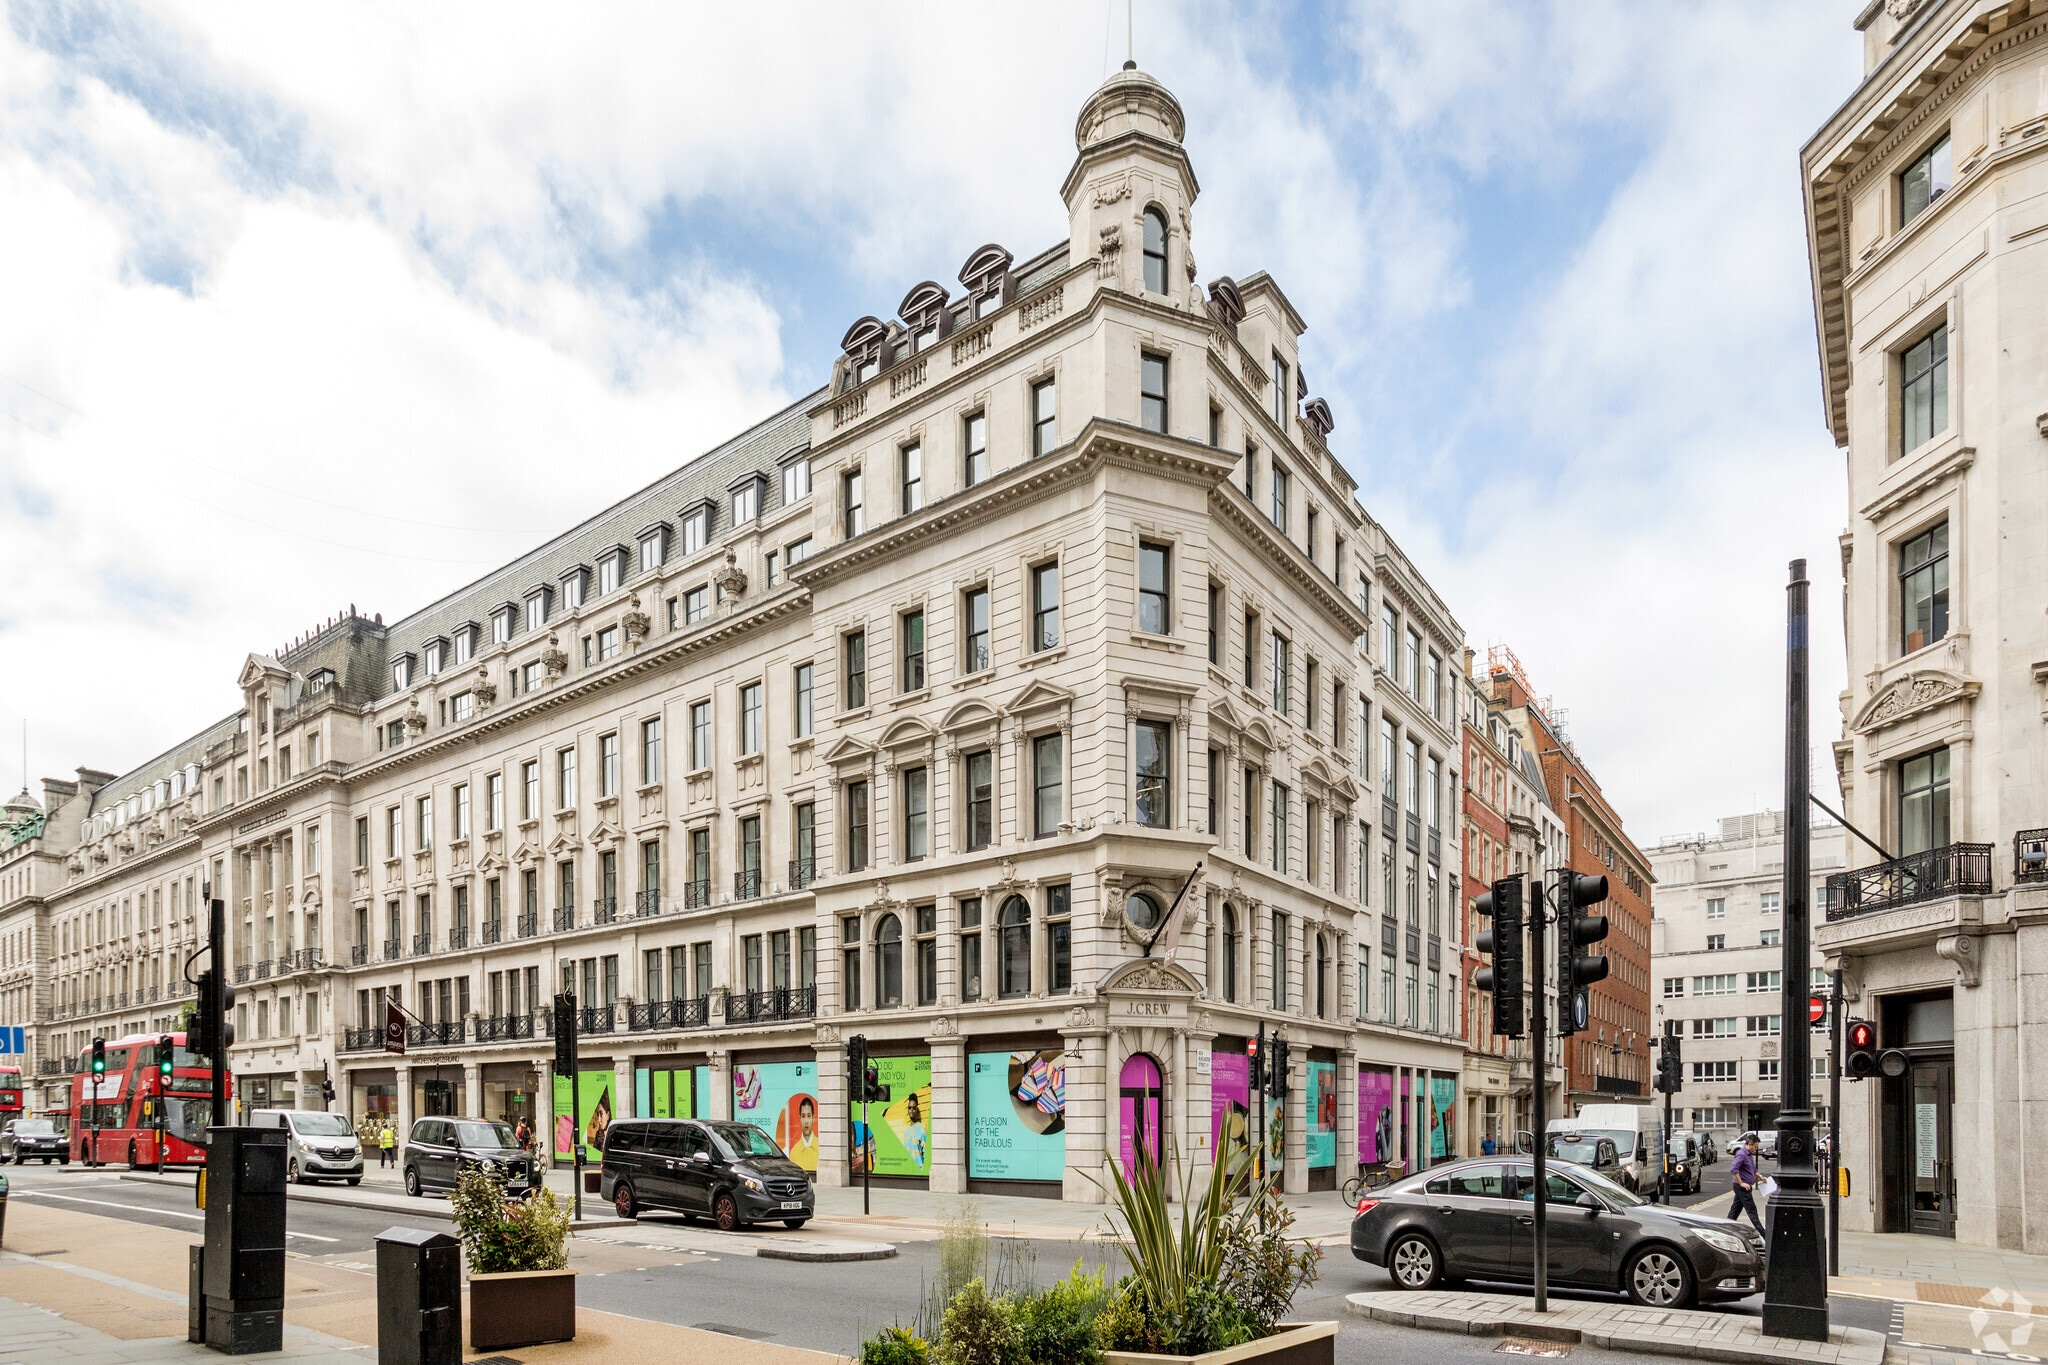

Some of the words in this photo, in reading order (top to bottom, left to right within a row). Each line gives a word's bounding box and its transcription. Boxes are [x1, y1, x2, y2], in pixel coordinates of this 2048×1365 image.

[1127, 1002, 1171, 1015] J.CREW
[892, 1071, 906, 1081] YOU
[4, 1094, 15, 1102] 94
[754, 1117, 772, 1127] DRESS
[975, 1117, 980, 1126] A
[981, 1116, 1008, 1127] FUSION
[975, 1127, 984, 1137] OF
[985, 1127, 1000, 1137] THE
[974, 1138, 1013, 1148] FABULOUS
